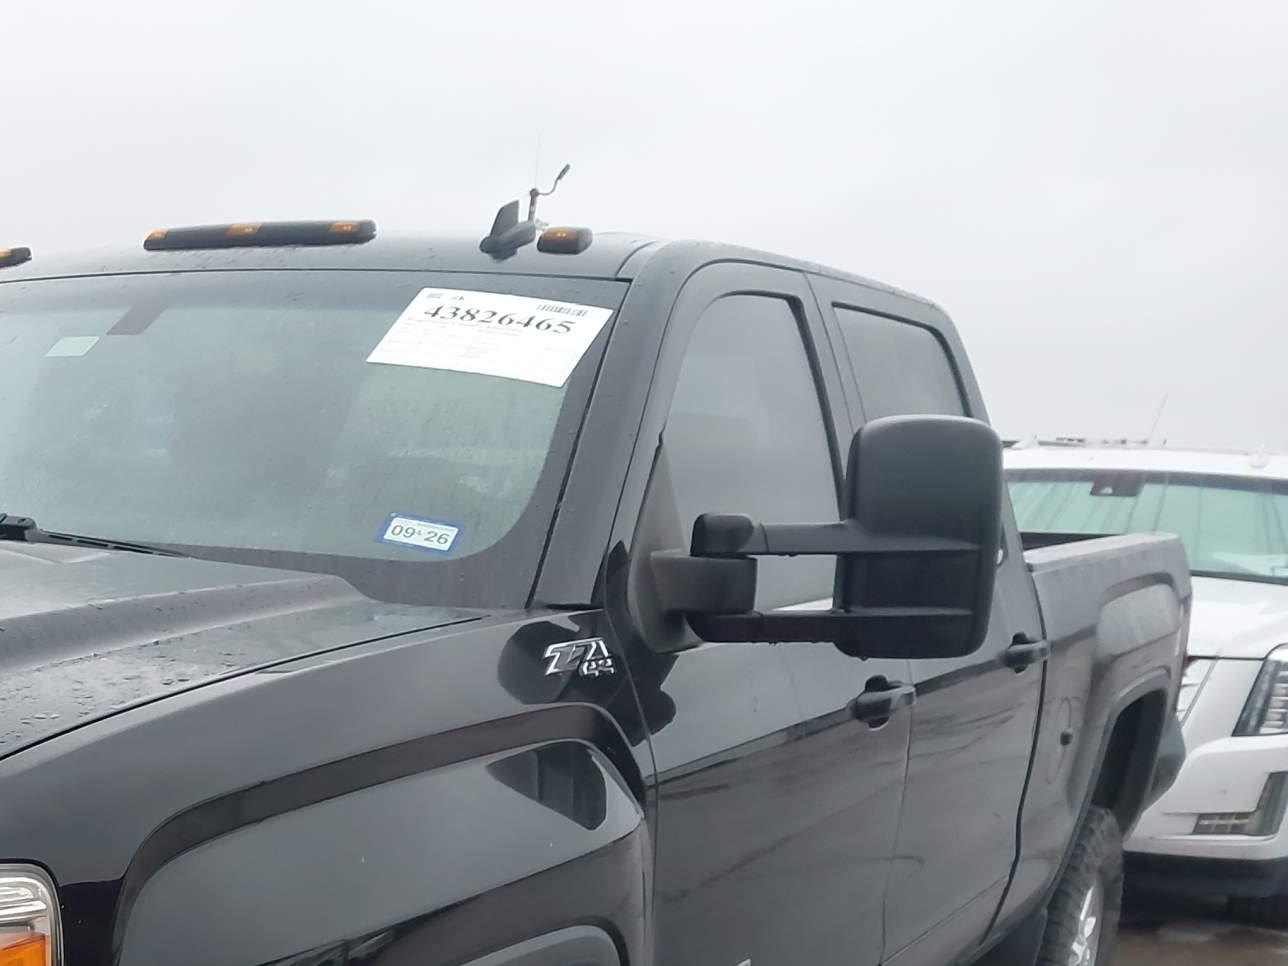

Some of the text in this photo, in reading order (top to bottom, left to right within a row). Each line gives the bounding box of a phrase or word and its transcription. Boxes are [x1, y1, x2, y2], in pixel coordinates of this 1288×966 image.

[423, 304, 576, 334] 43826465
[391, 524, 450, 545] 09 26
